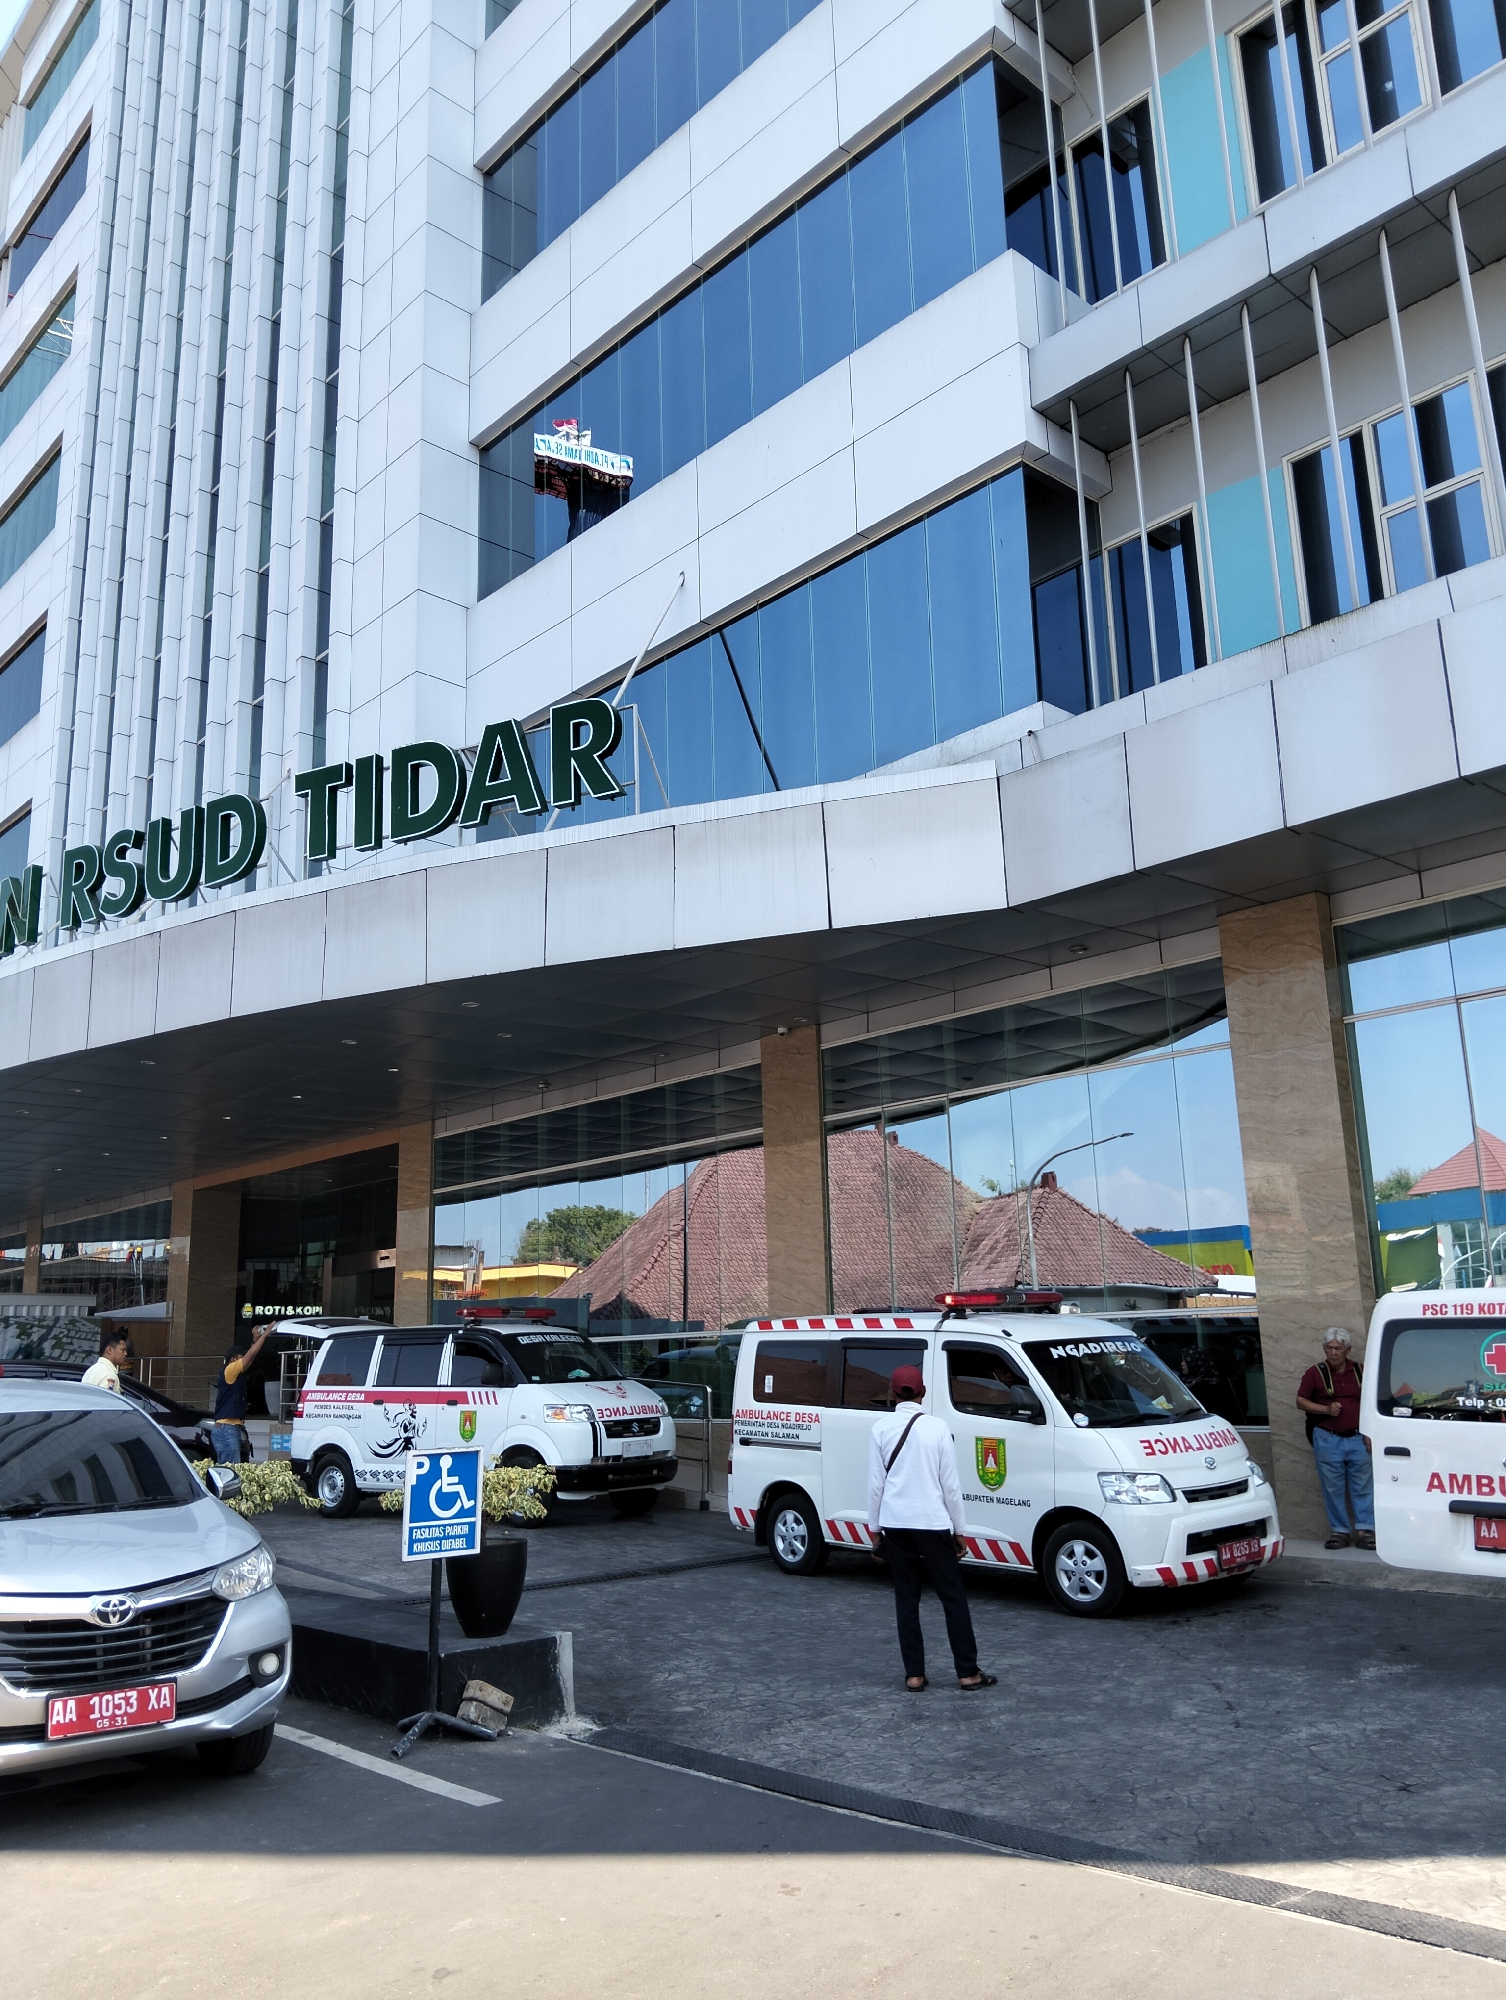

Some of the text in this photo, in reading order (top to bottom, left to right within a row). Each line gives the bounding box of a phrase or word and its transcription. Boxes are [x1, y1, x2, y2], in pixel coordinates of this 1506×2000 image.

[60, 793, 267, 931] RSUD
[295, 698, 624, 862] TIDAR
[1422, 1302, 1506, 1316] PSC 119 KOT
[517, 1334, 546, 1344] DESA
[1049, 1341, 1141, 1358] NGADIREJO
[306, 1392, 365, 1401] AMBULANCE DESA
[1456, 1396, 1484, 1409] Telp
[735, 1409, 820, 1424] AMBULANCE DESA
[734, 1419, 812, 1431] PEMERINTAH DESA NGADIREJO
[734, 1429, 800, 1440] KECAMATAN SALAMAN
[962, 1493, 1031, 1508] ABUPATEN MAGELANG
[412, 1524, 469, 1540] FASILITAS PARKIR
[1480, 1521, 1498, 1539] AA
[413, 1538, 467, 1553] KHUSUS DIFABEL
[1222, 1546, 1231, 1560] AA
[1233, 1541, 1249, 1557] 8265
[52, 1686, 171, 1725] AA 1053 XA
